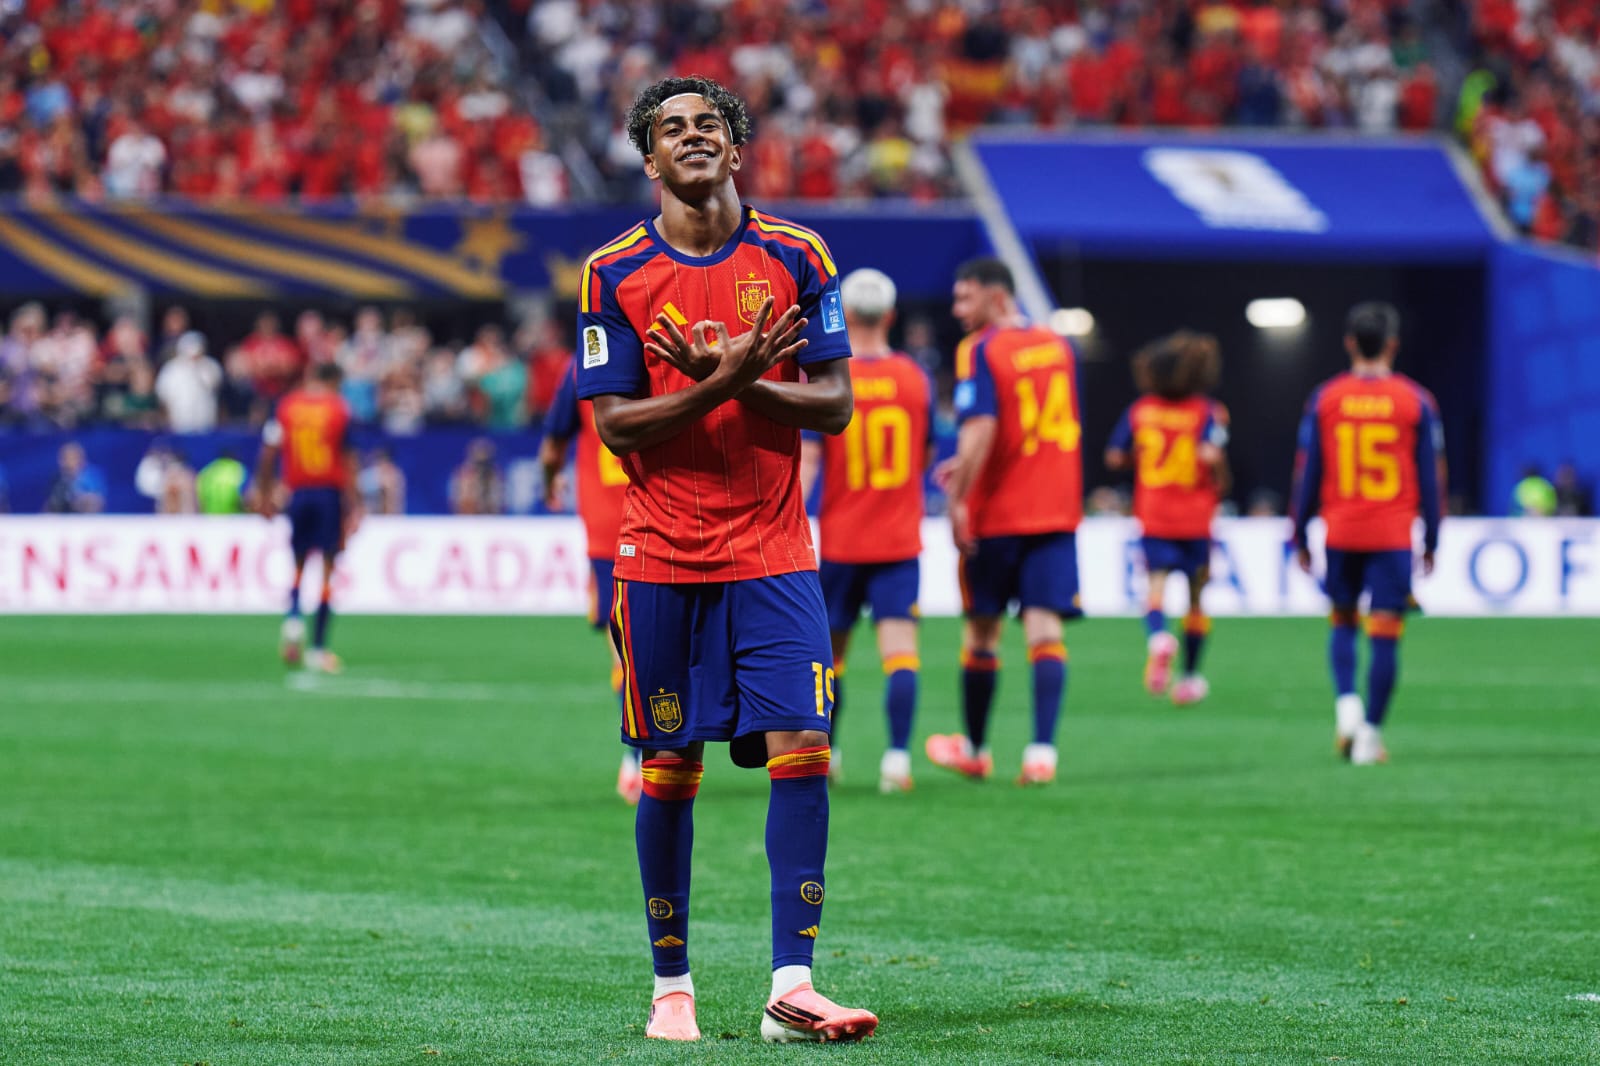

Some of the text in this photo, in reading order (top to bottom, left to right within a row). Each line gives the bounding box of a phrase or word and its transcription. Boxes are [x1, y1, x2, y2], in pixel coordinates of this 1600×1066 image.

[844, 404, 911, 491] 10
[1015, 372, 1081, 456] 14
[1136, 427, 1196, 489] 24
[1335, 421, 1401, 501] 15
[381, 536, 579, 600] CADA
[1468, 537, 1592, 600] OF
